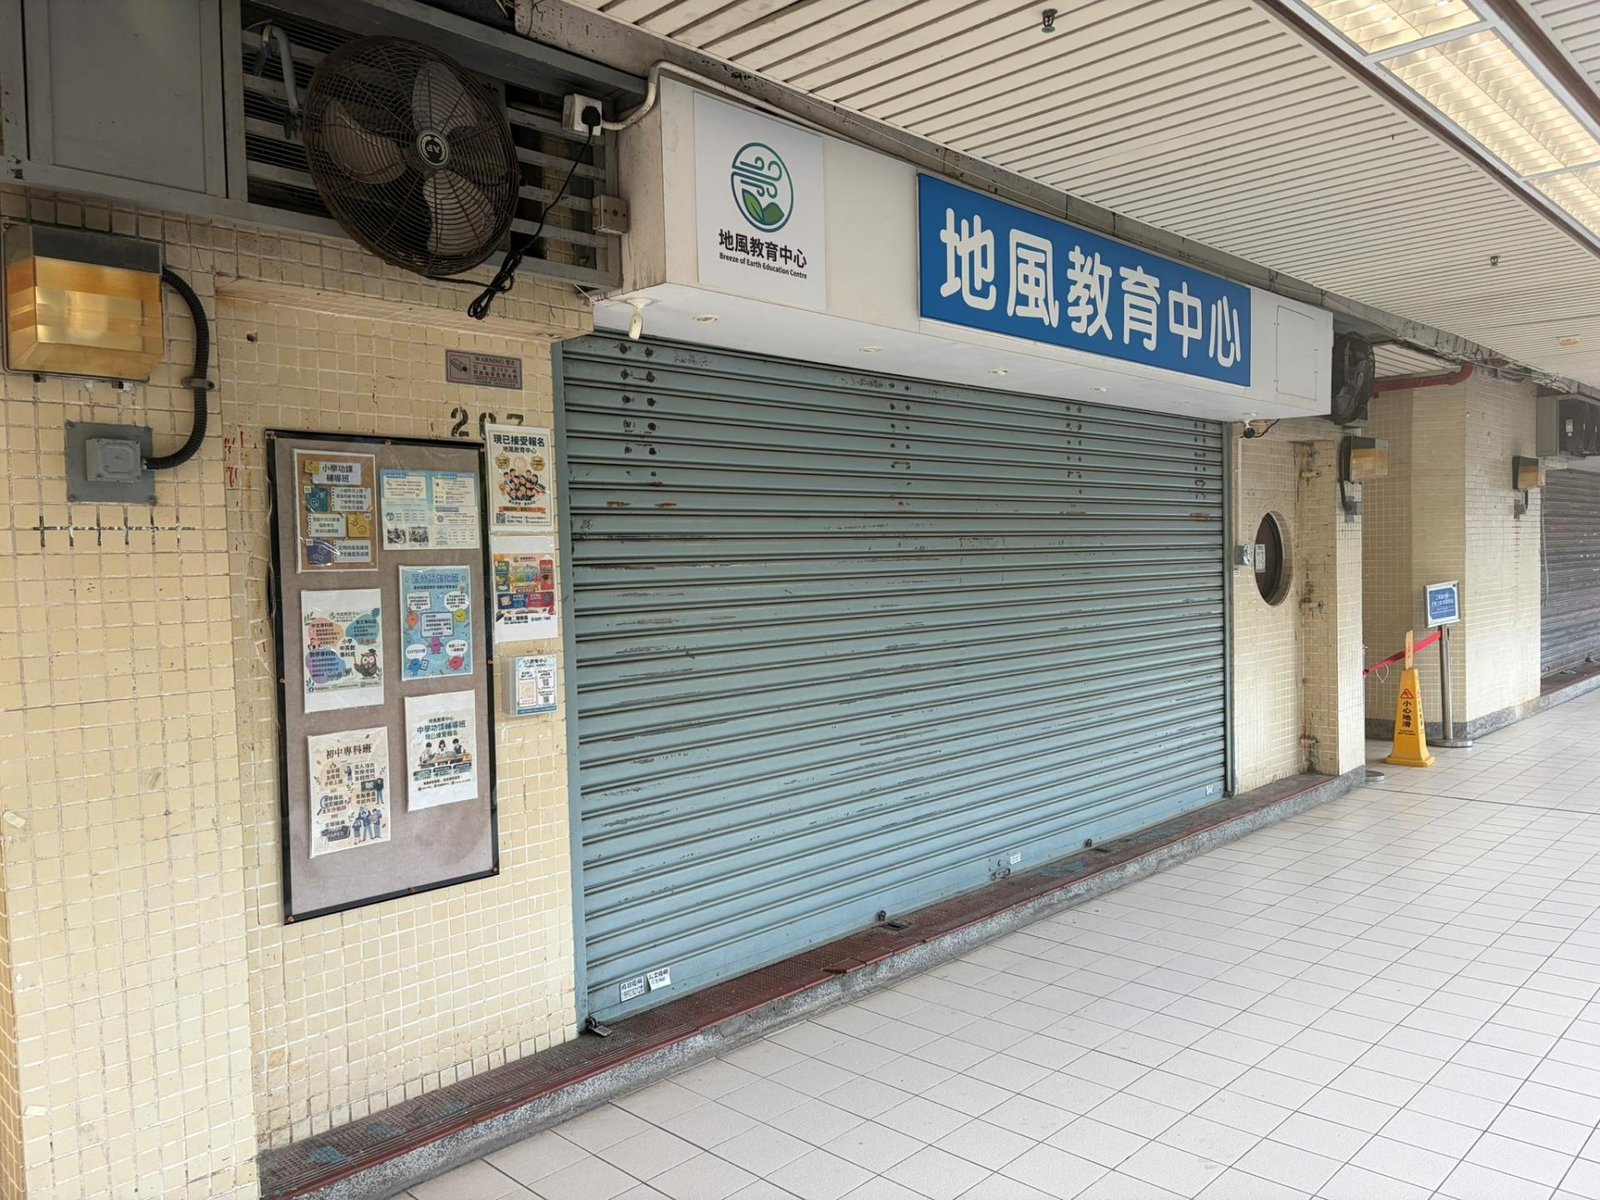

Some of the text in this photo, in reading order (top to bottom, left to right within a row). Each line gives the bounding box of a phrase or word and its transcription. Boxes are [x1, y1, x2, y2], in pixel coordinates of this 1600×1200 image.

[718, 229, 807, 269] 地風教育中心
[719, 252, 808, 279] Breeze of Earth Education Centre
[940, 207, 1242, 368] 地風教育中心
[474, 356, 504, 364] WARNING
[493, 434, 545, 447] 現已接受報名
[503, 446, 537, 454] 地風教育中心
[322, 464, 353, 473] 小學功課
[1402, 700, 1412, 728] 小心地滑
[326, 743, 372, 760] 初中專科班
